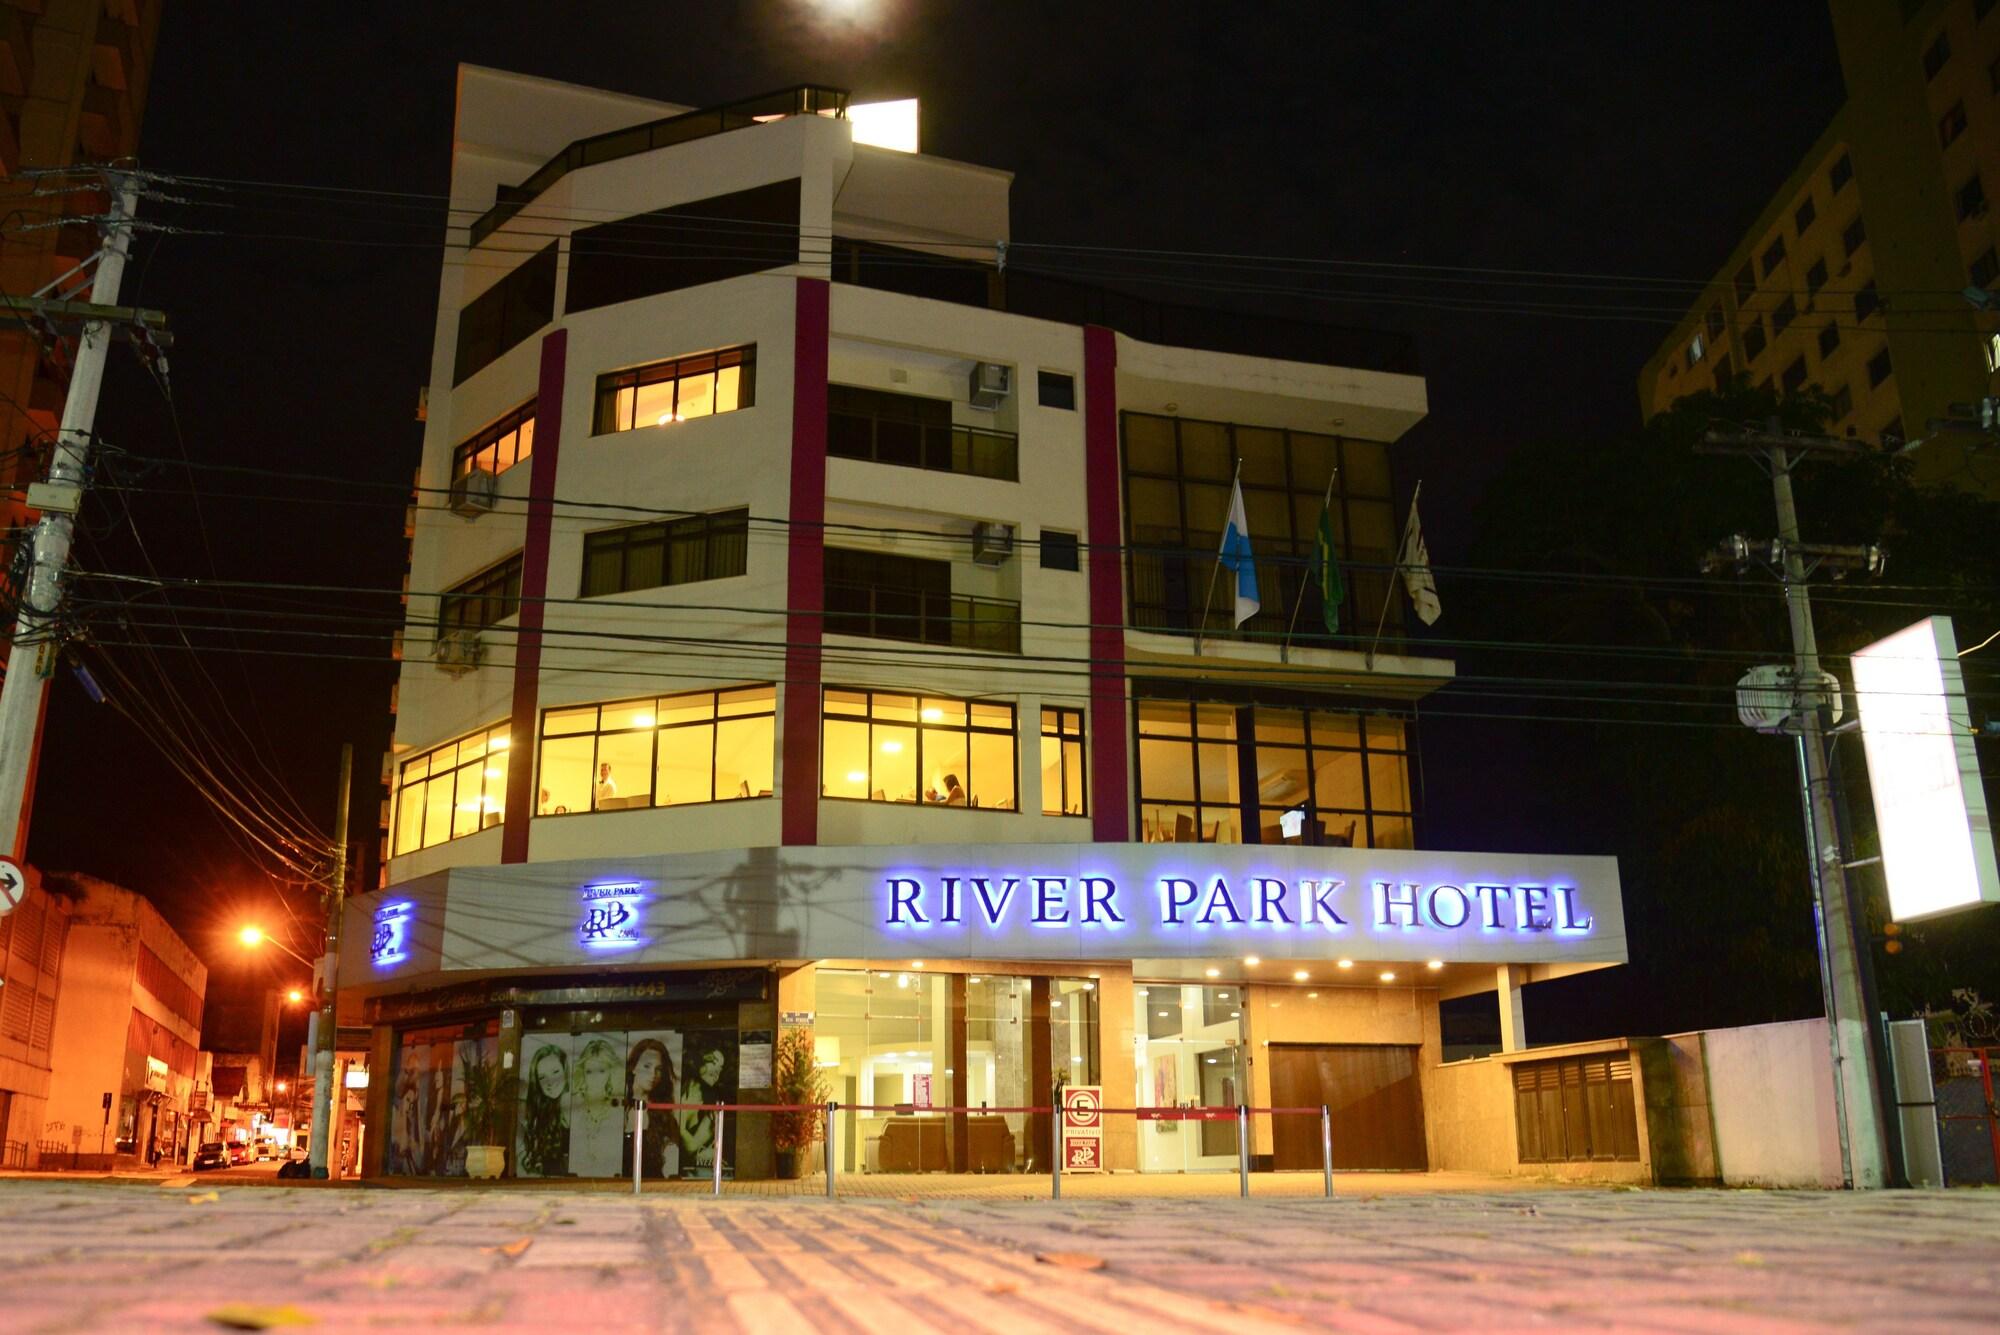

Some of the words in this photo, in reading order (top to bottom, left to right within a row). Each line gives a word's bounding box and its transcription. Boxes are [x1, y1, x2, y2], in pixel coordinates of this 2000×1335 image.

[885, 876, 1126, 925] RIVER
[1160, 878, 1348, 925] PARK
[1375, 882, 1595, 931] HOTEL
[1077, 1099, 1089, 1117] E
